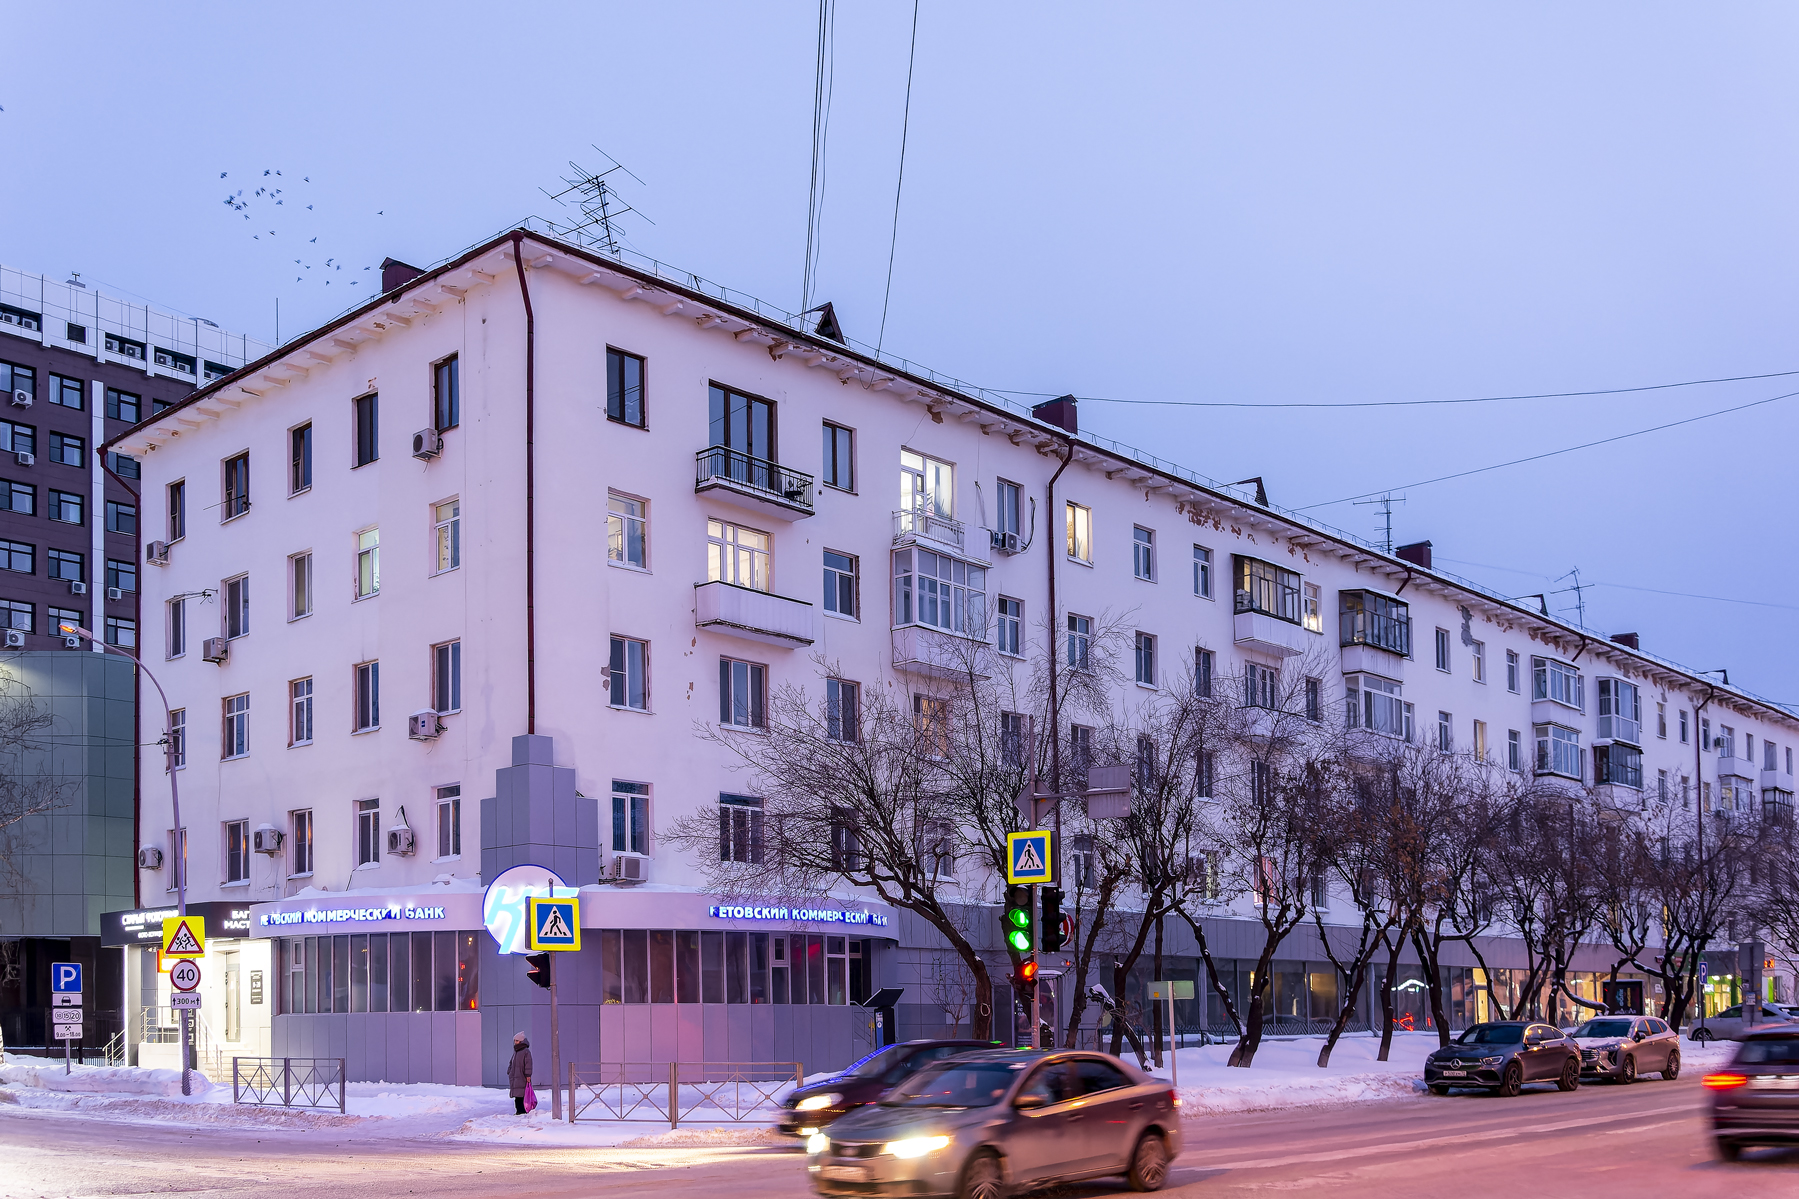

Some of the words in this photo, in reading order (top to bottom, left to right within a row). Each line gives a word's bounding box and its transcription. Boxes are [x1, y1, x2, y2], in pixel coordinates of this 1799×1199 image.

[232, 911, 250, 919] БАГ
[405, 906, 445, 920] БАНК
[60, 966, 77, 990] P
[176, 968, 195, 982] 40
[1701, 964, 1707, 982] P
